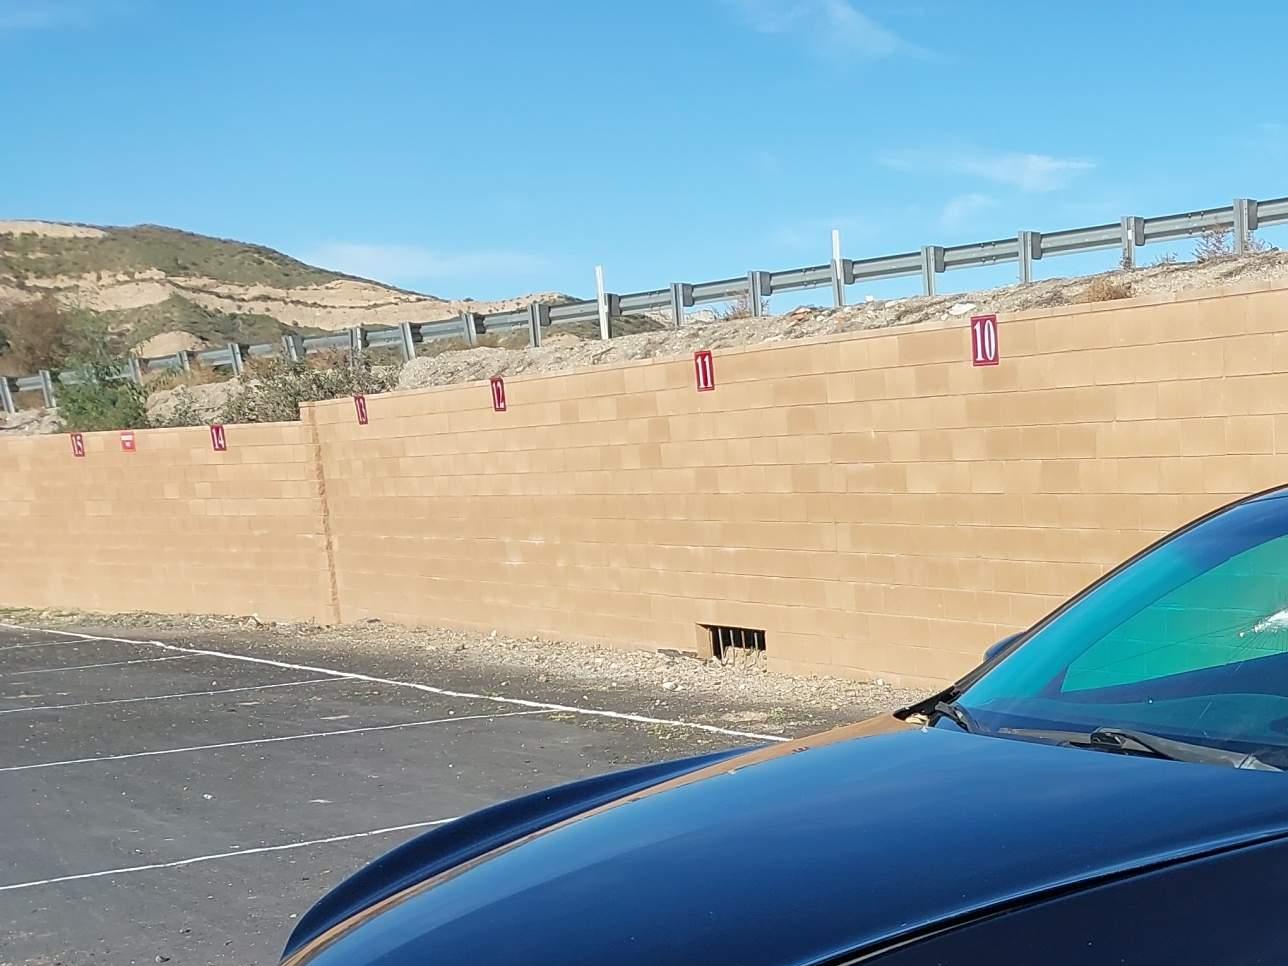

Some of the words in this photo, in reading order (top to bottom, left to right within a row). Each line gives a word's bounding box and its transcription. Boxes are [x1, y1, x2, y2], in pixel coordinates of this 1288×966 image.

[974, 319, 996, 361] 10
[696, 354, 713, 388] 11
[492, 380, 505, 409] 12
[211, 427, 225, 449] 14
